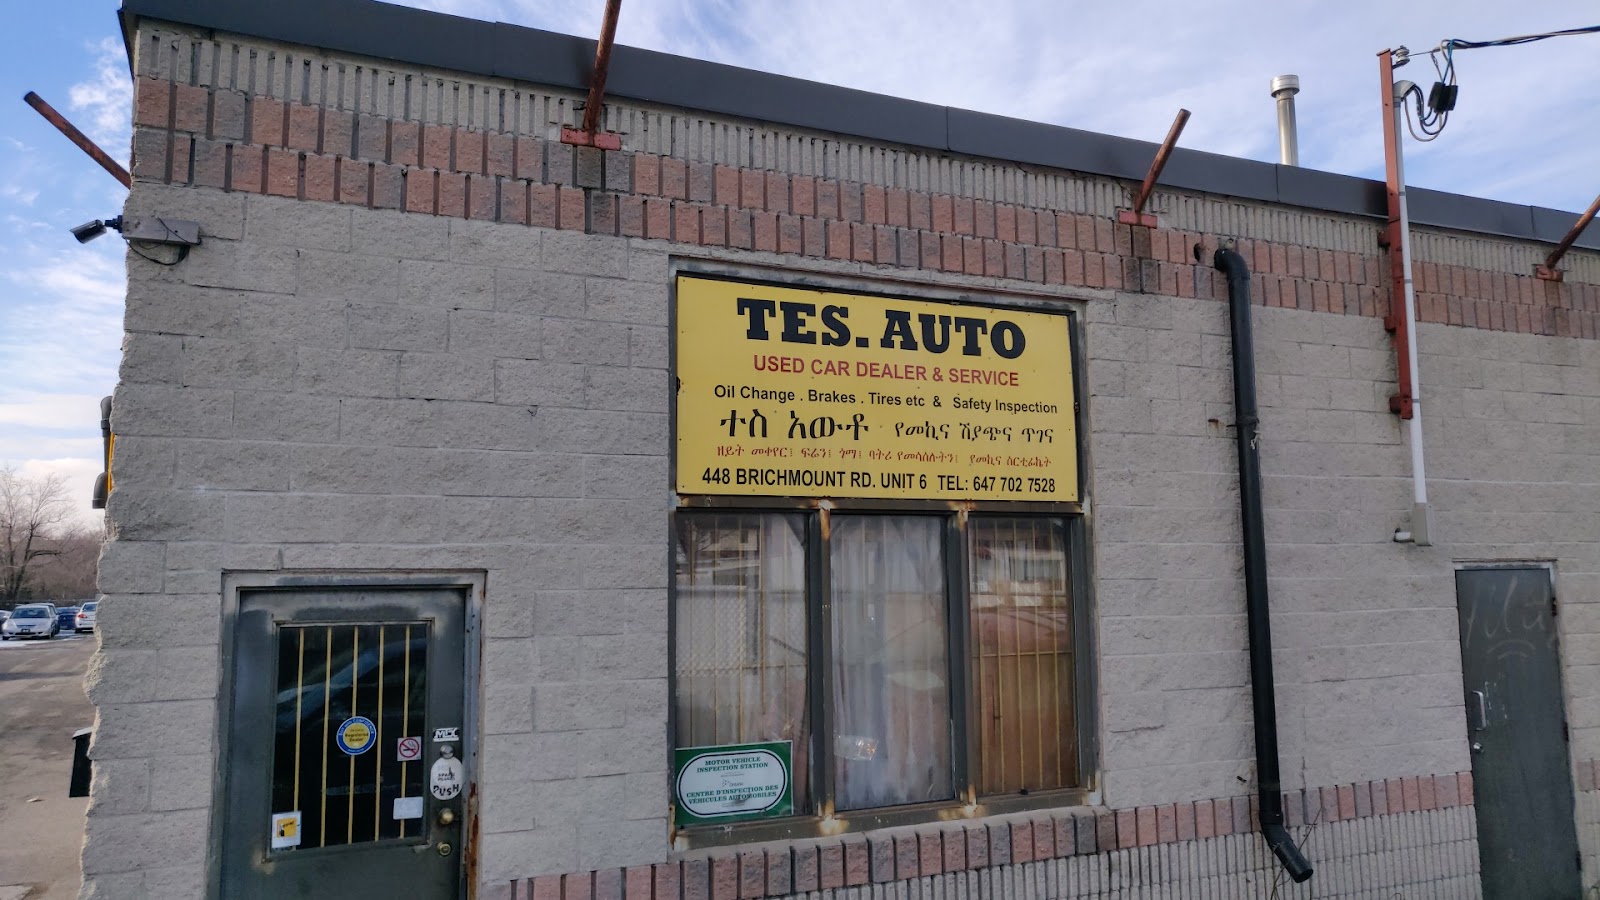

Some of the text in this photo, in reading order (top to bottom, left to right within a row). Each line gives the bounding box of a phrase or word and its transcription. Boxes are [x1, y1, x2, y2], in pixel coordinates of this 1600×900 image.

[880, 309, 1026, 359] AUTO
[754, 355, 1019, 386] USED CAR DEALER & SERVICE
[715, 385, 734, 398] Oil
[740, 386, 794, 403] Change
[808, 390, 856, 403] Brakes
[868, 392, 901, 405] Tires
[906, 395, 925, 406] etc
[933, 396, 941, 407] &
[953, 397, 991, 413] Safety
[996, 399, 1057, 415] Inspection
[720, 409, 1053, 443] ተስ አውቶ የመኪና ሽያጭና ጥገና
[718, 444, 744, 457] ዘይት
[869, 449, 891, 460] ባትሪ
[970, 454, 1001, 466] የመኪና
[702, 468, 1055, 492] 448 BRICHMOUNT RD. UNIT 6 TEL: 647 702 7528
[697, 765, 738, 773] INSPECTION
[433, 784, 459, 796] PUSH
[716, 786, 764, 795] D'INSPECTION
[729, 792, 777, 800] AUTOMOBILES
